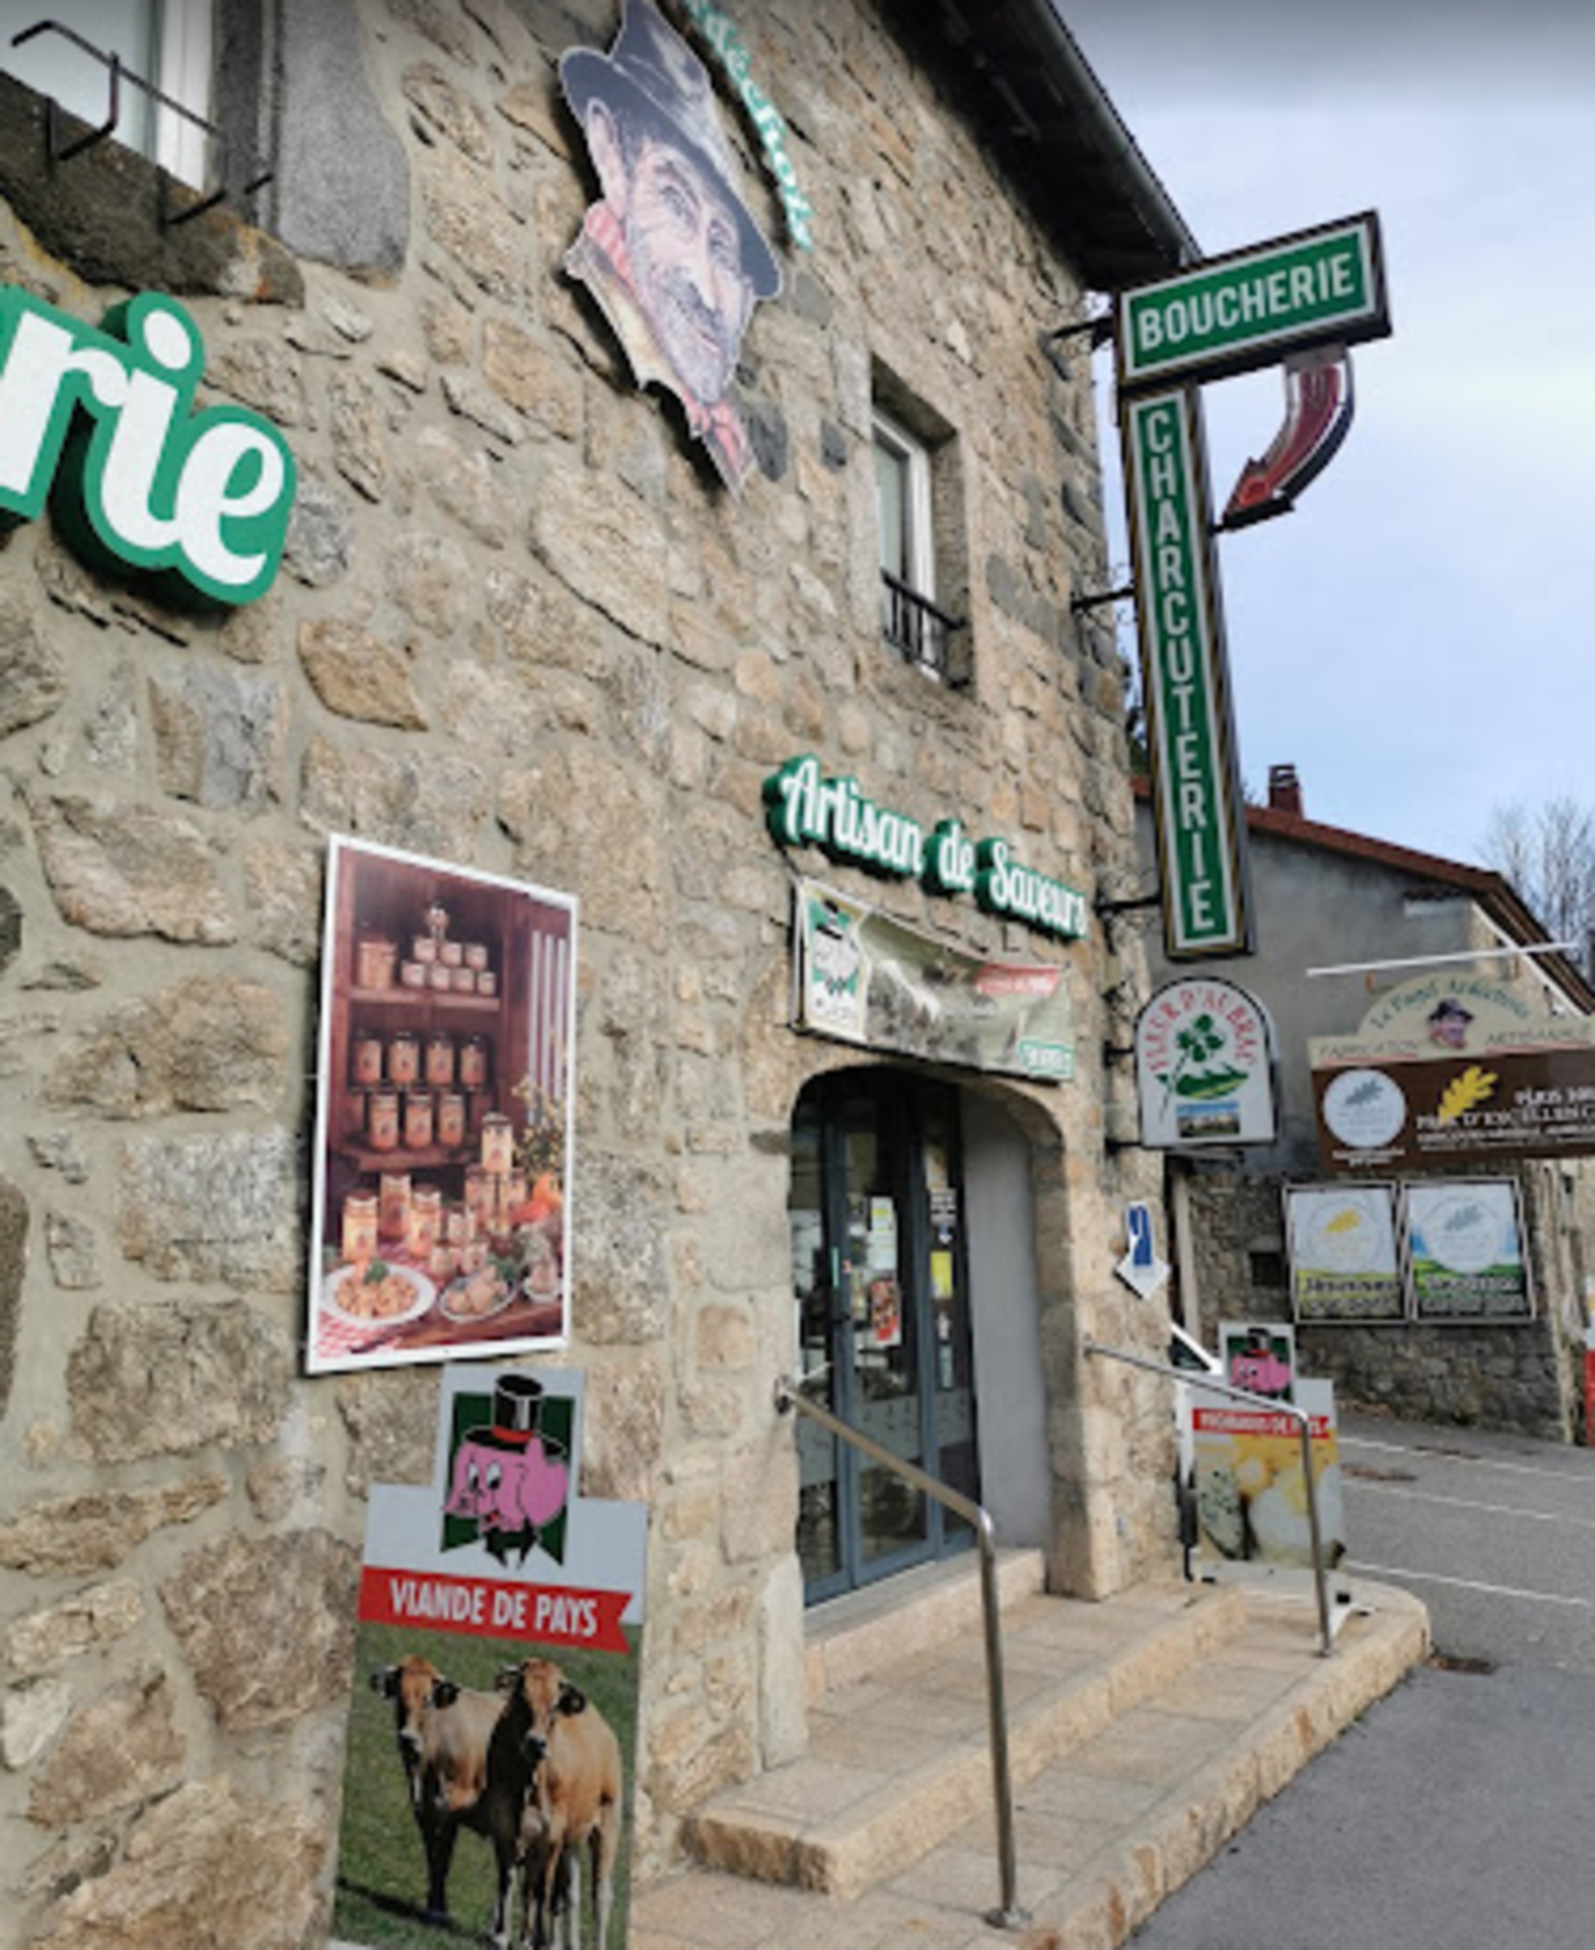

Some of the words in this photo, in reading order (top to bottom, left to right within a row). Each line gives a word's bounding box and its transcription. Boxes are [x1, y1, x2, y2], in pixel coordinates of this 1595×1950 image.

[1137, 252, 1355, 352] BOUCHERIE
[1146, 409, 1216, 932] CHARCUTERIE
[780, 757, 923, 874] Artisan
[937, 818, 976, 889] de
[988, 840, 1089, 932] Saveurs
[389, 1578, 486, 1625] VIANDE
[491, 1590, 530, 1630] DE
[534, 1593, 598, 1638] PAYS
